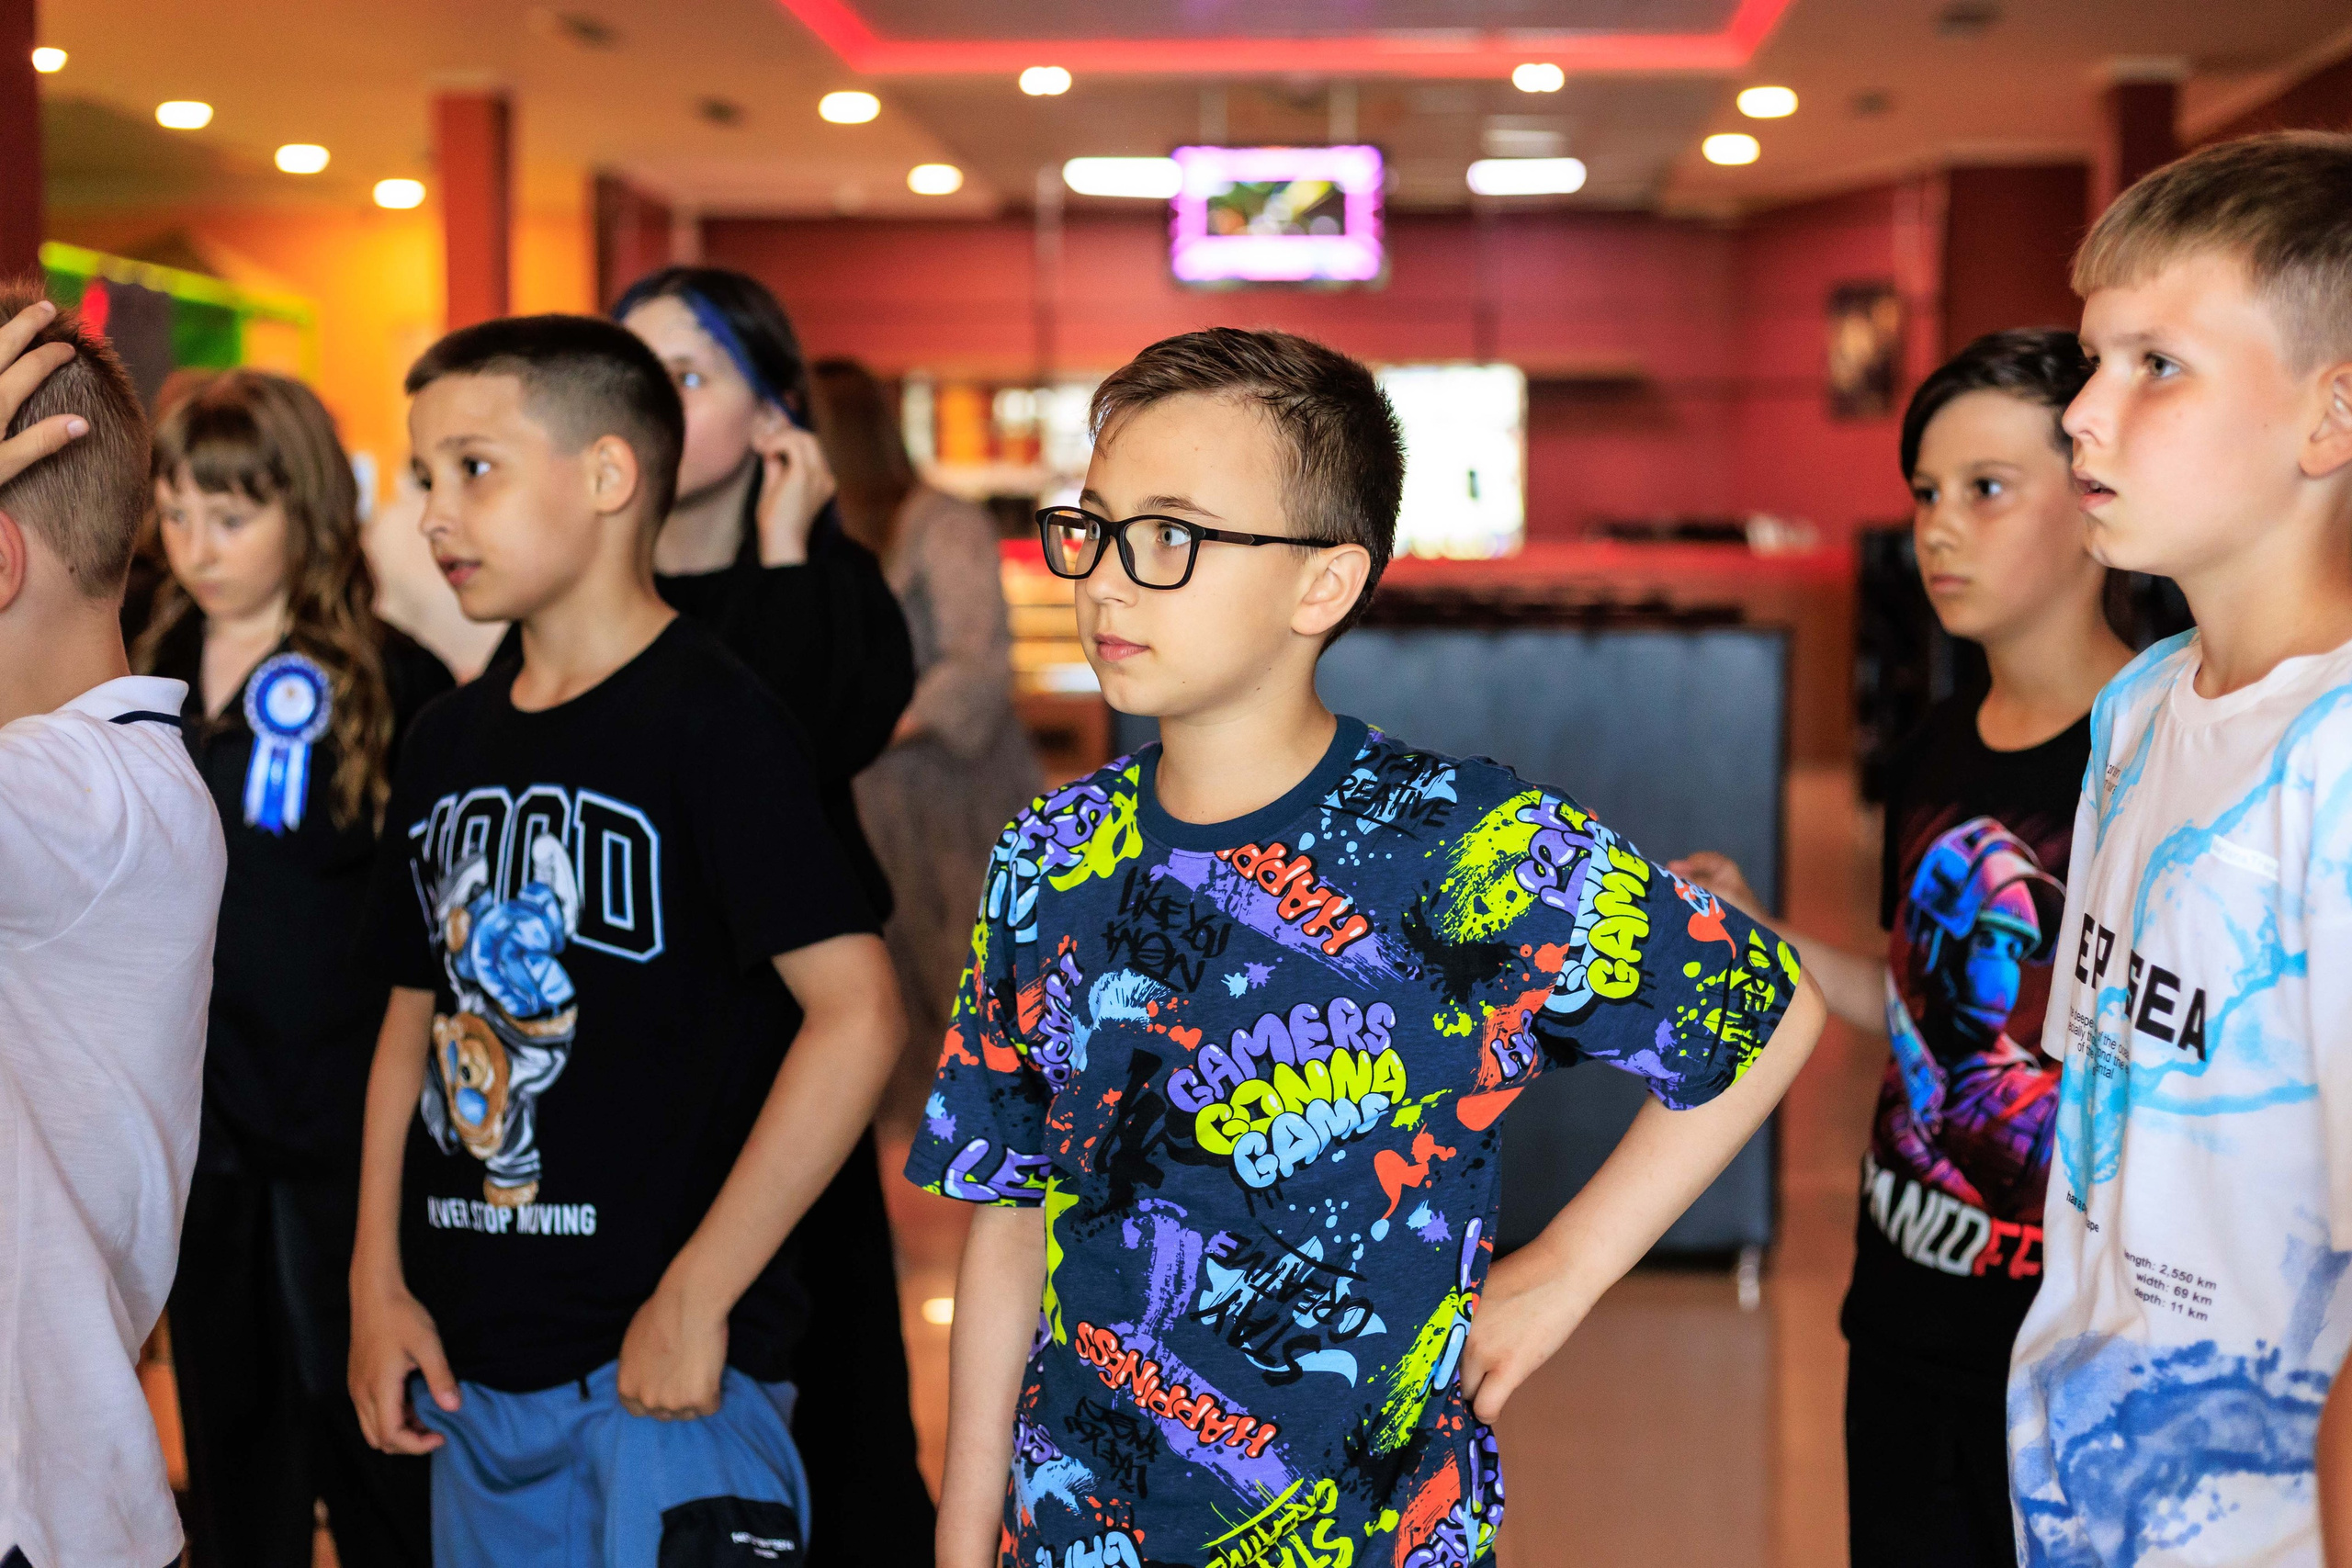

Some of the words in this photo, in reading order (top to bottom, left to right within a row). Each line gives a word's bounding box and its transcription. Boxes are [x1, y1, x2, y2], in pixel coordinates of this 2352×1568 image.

[410, 784, 665, 964] OOD
[1216, 841, 1369, 956] HAPP
[1586, 843, 1650, 999] GAME
[2075, 912, 2116, 990] EP
[2125, 948, 2206, 1063] SEA
[1166, 996, 1396, 1113] GAMERS
[2076, 1041, 2086, 1054] of
[2103, 1034, 2117, 1050] the
[1194, 1047, 1408, 1156] GONNA
[1233, 1092, 1390, 1189] GAME
[2065, 1190, 2078, 1206] has
[2086, 1218, 2099, 1233] ape
[1206, 1232, 1374, 1344] CREATIVE
[2124, 1249, 2156, 1271] length:
[2159, 1264, 2194, 1284] 2,550
[2197, 1276, 2217, 1291] km
[2134, 1287, 2165, 1308] depth:
[2170, 1301, 2184, 1314] 11
[2188, 1306, 2209, 1322] km
[2136, 1272, 2169, 1292] width:
[2173, 1286, 2189, 1299] 69
[2192, 1292, 2212, 1306] km
[1189, 1290, 1321, 1386] STAY
[1075, 1321, 1277, 1458] HAPPINESS
